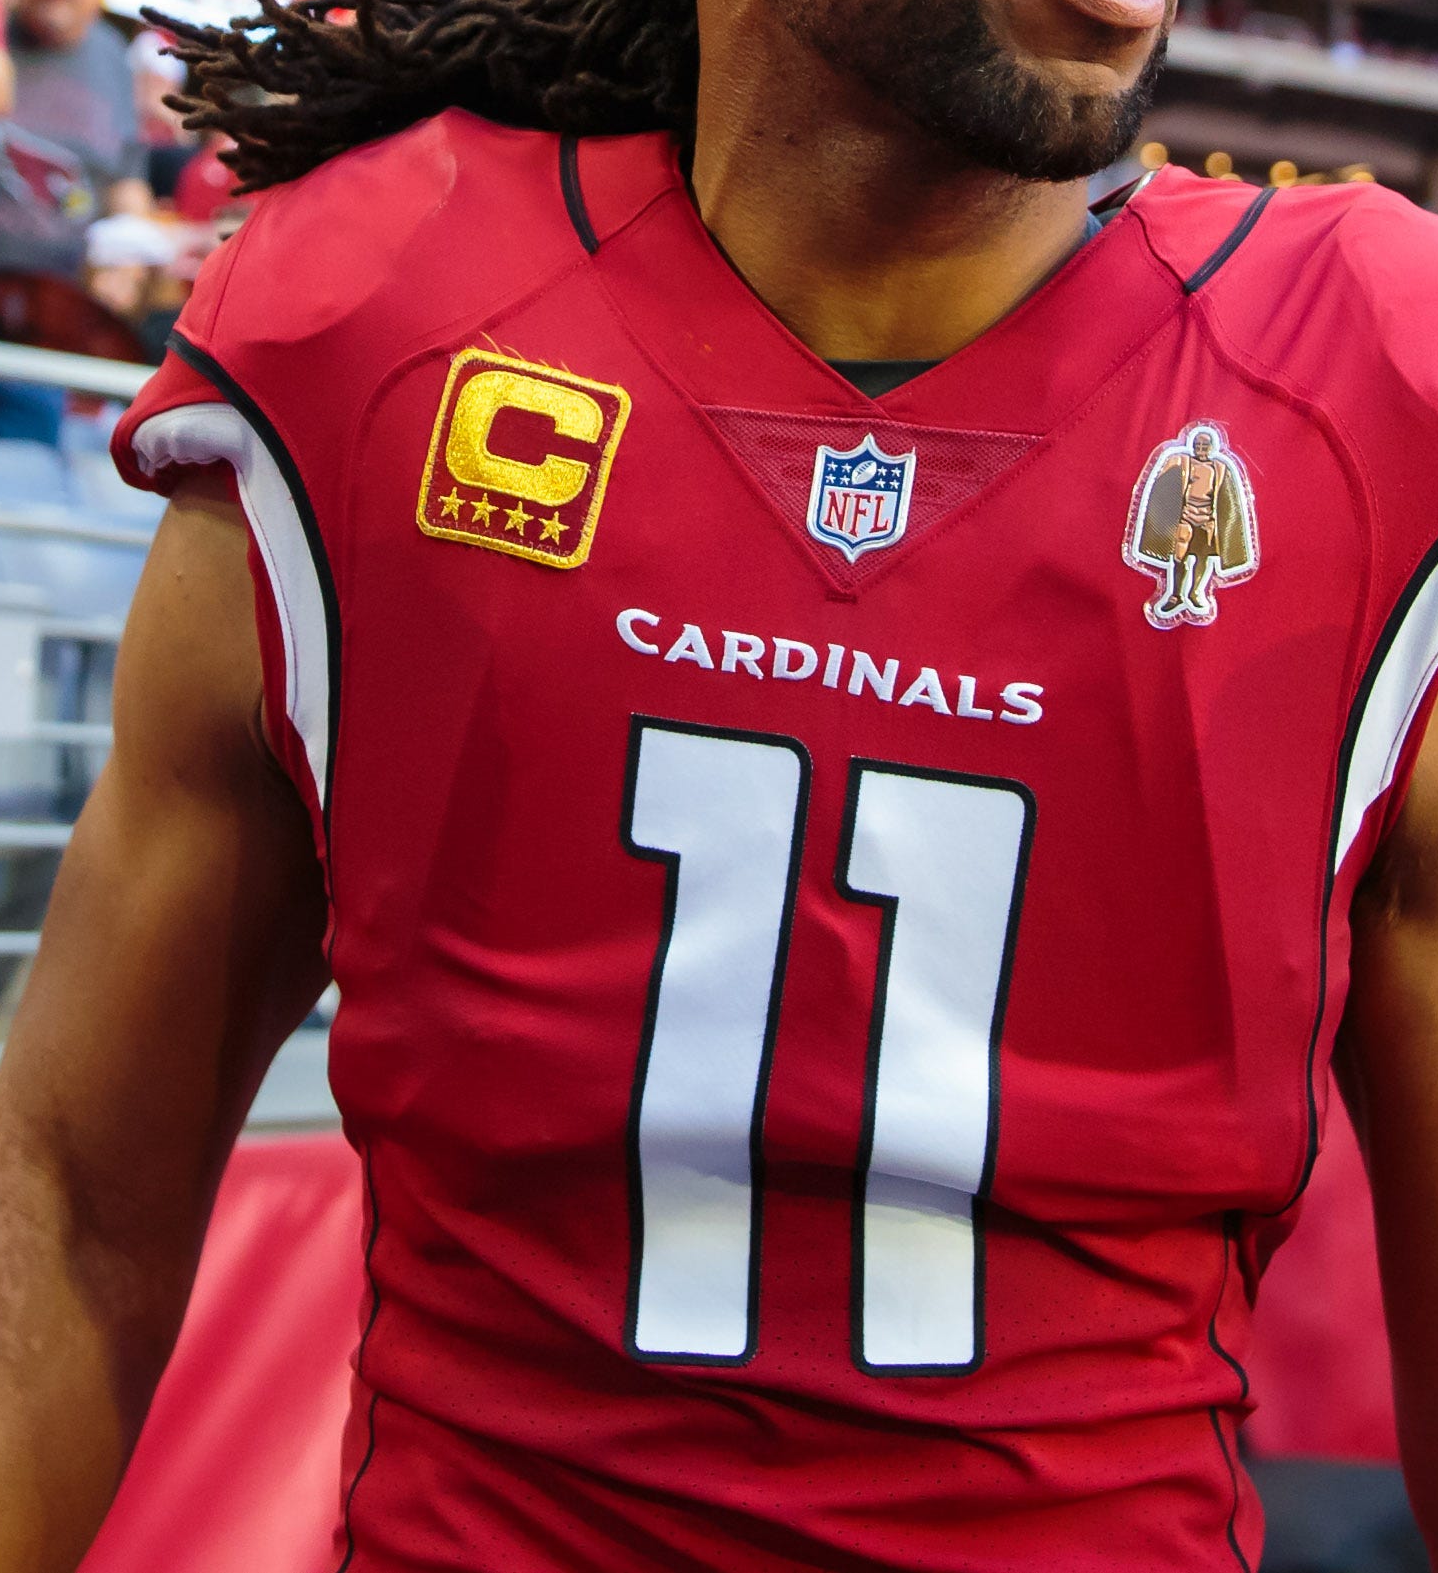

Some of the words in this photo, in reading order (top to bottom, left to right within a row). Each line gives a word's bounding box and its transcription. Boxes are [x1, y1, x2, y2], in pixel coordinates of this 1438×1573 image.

[446, 370, 604, 507] C
[823, 490, 890, 538] NFL
[615, 607, 1045, 725] CARDINALS
[619, 713, 1037, 1378] 11
